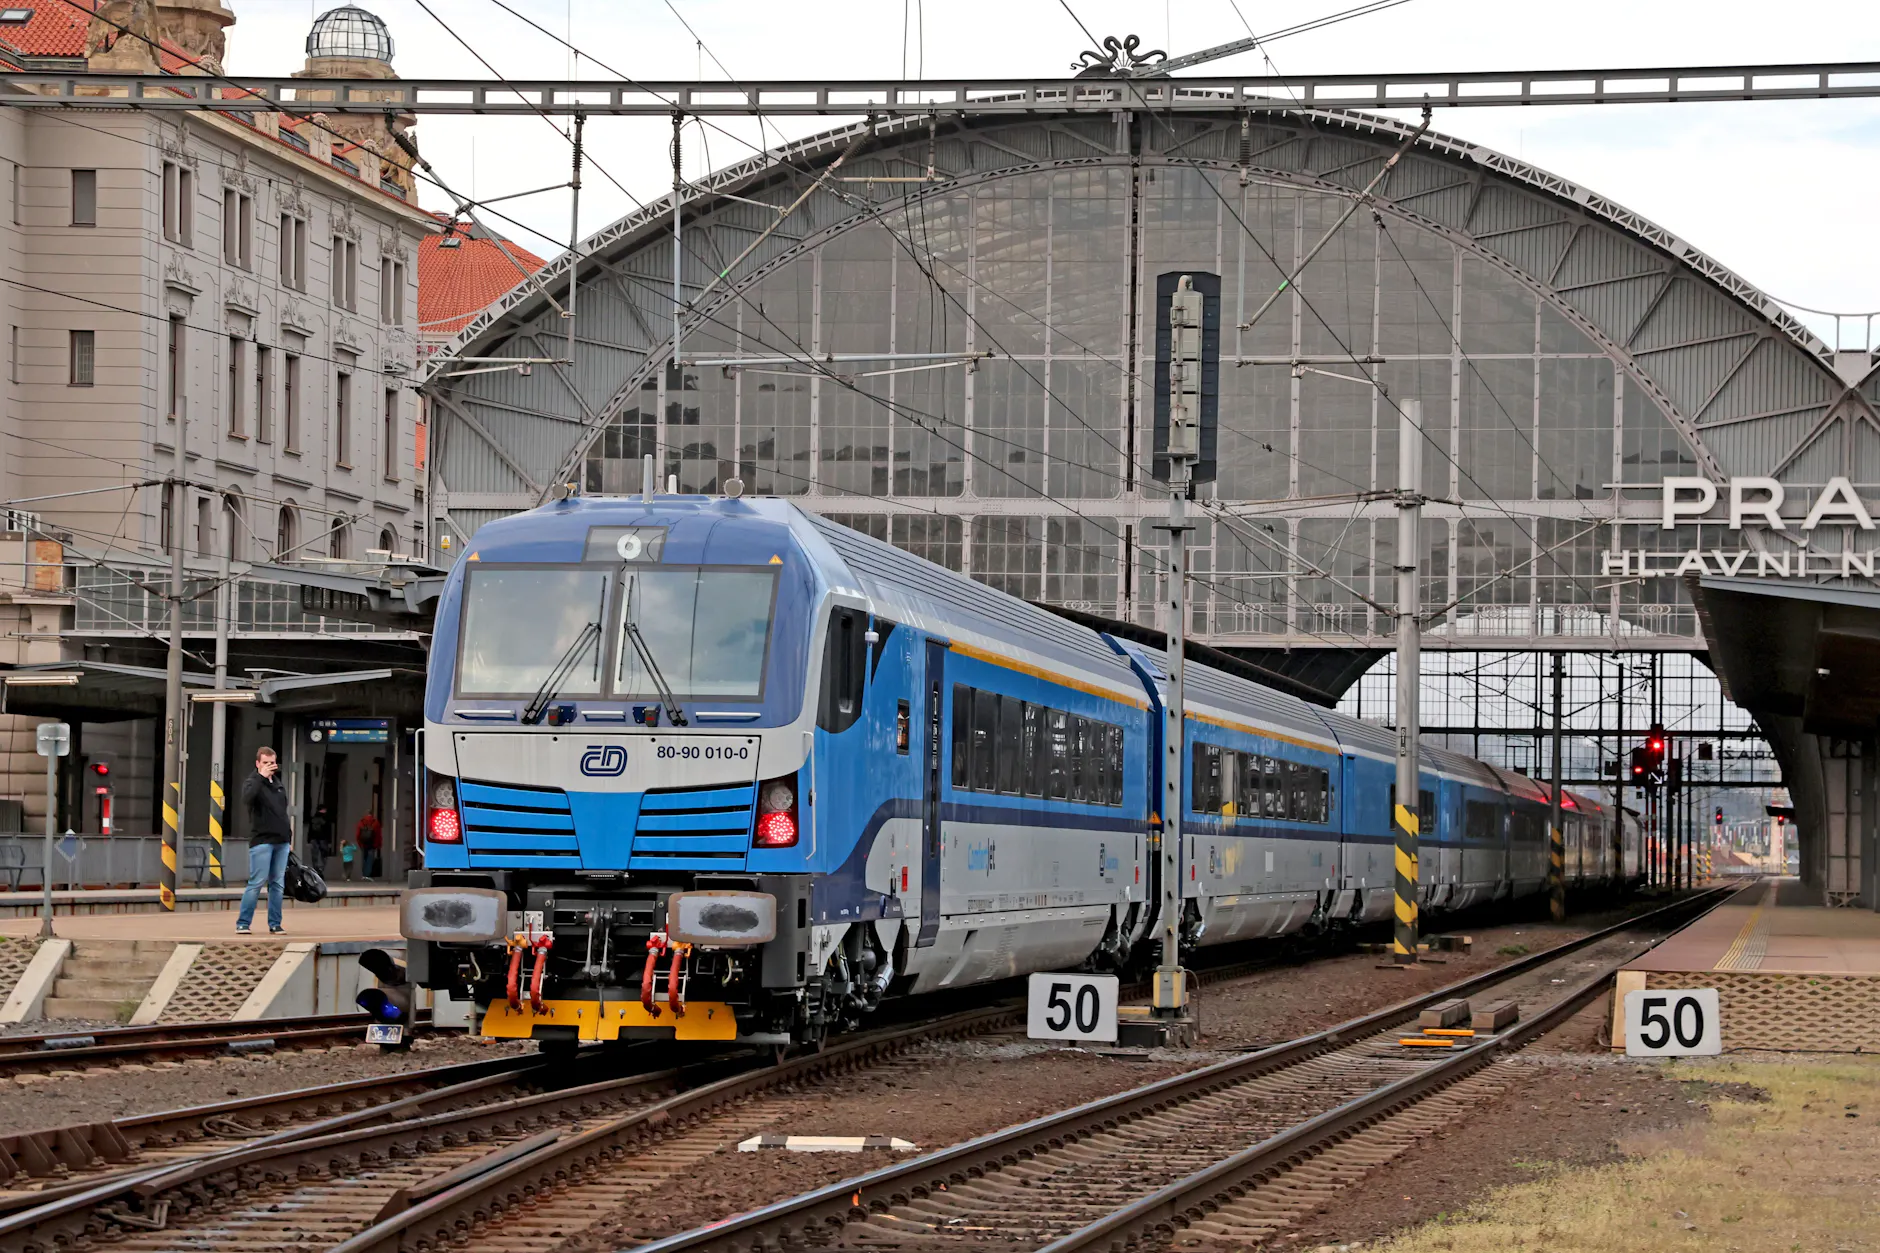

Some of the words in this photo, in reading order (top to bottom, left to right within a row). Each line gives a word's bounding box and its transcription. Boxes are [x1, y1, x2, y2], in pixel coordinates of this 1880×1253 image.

[1662, 476, 1877, 530] PRA
[657, 746, 700, 759] 80-90
[705, 747, 748, 759] 010-0
[1046, 983, 1100, 1033] 50
[1641, 996, 1704, 1049] 50
